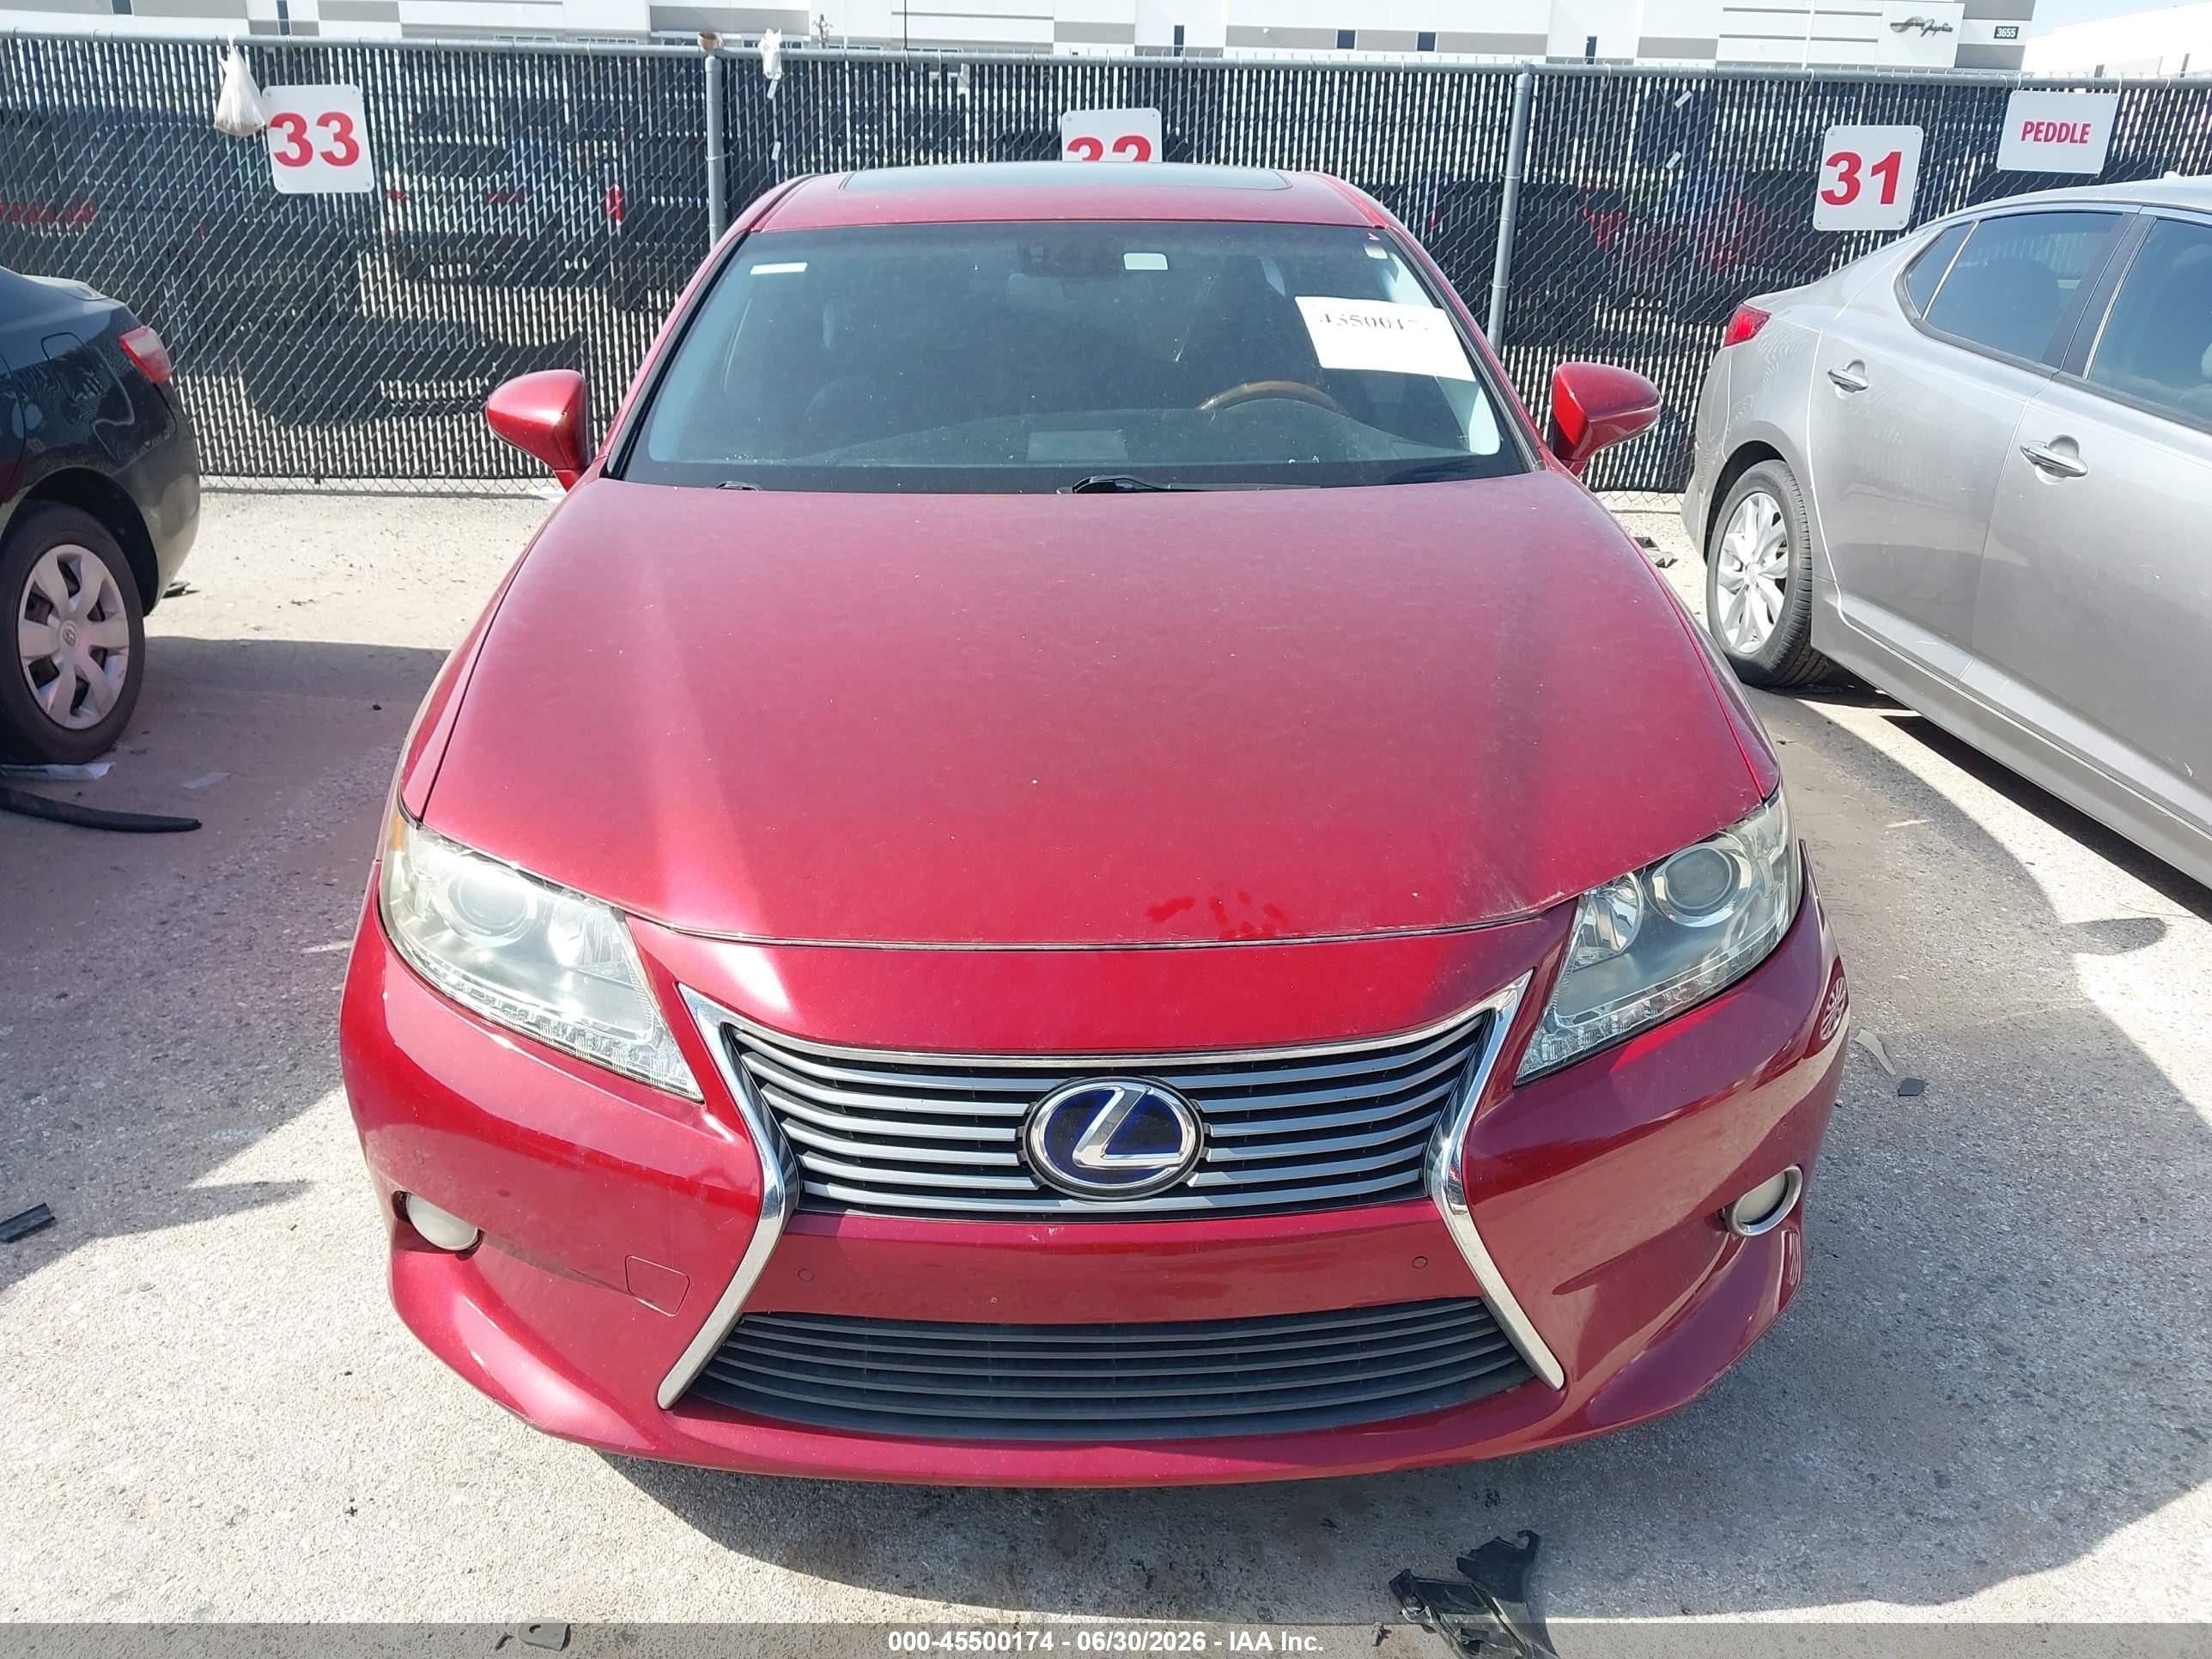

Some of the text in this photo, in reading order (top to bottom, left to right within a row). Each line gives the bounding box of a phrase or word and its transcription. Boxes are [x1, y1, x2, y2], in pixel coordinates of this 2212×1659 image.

[1996, 27, 2017, 38] 3655
[271, 112, 360, 167] 33
[2021, 121, 2091, 144] PEDDLE
[1820, 151, 1902, 206] 31
